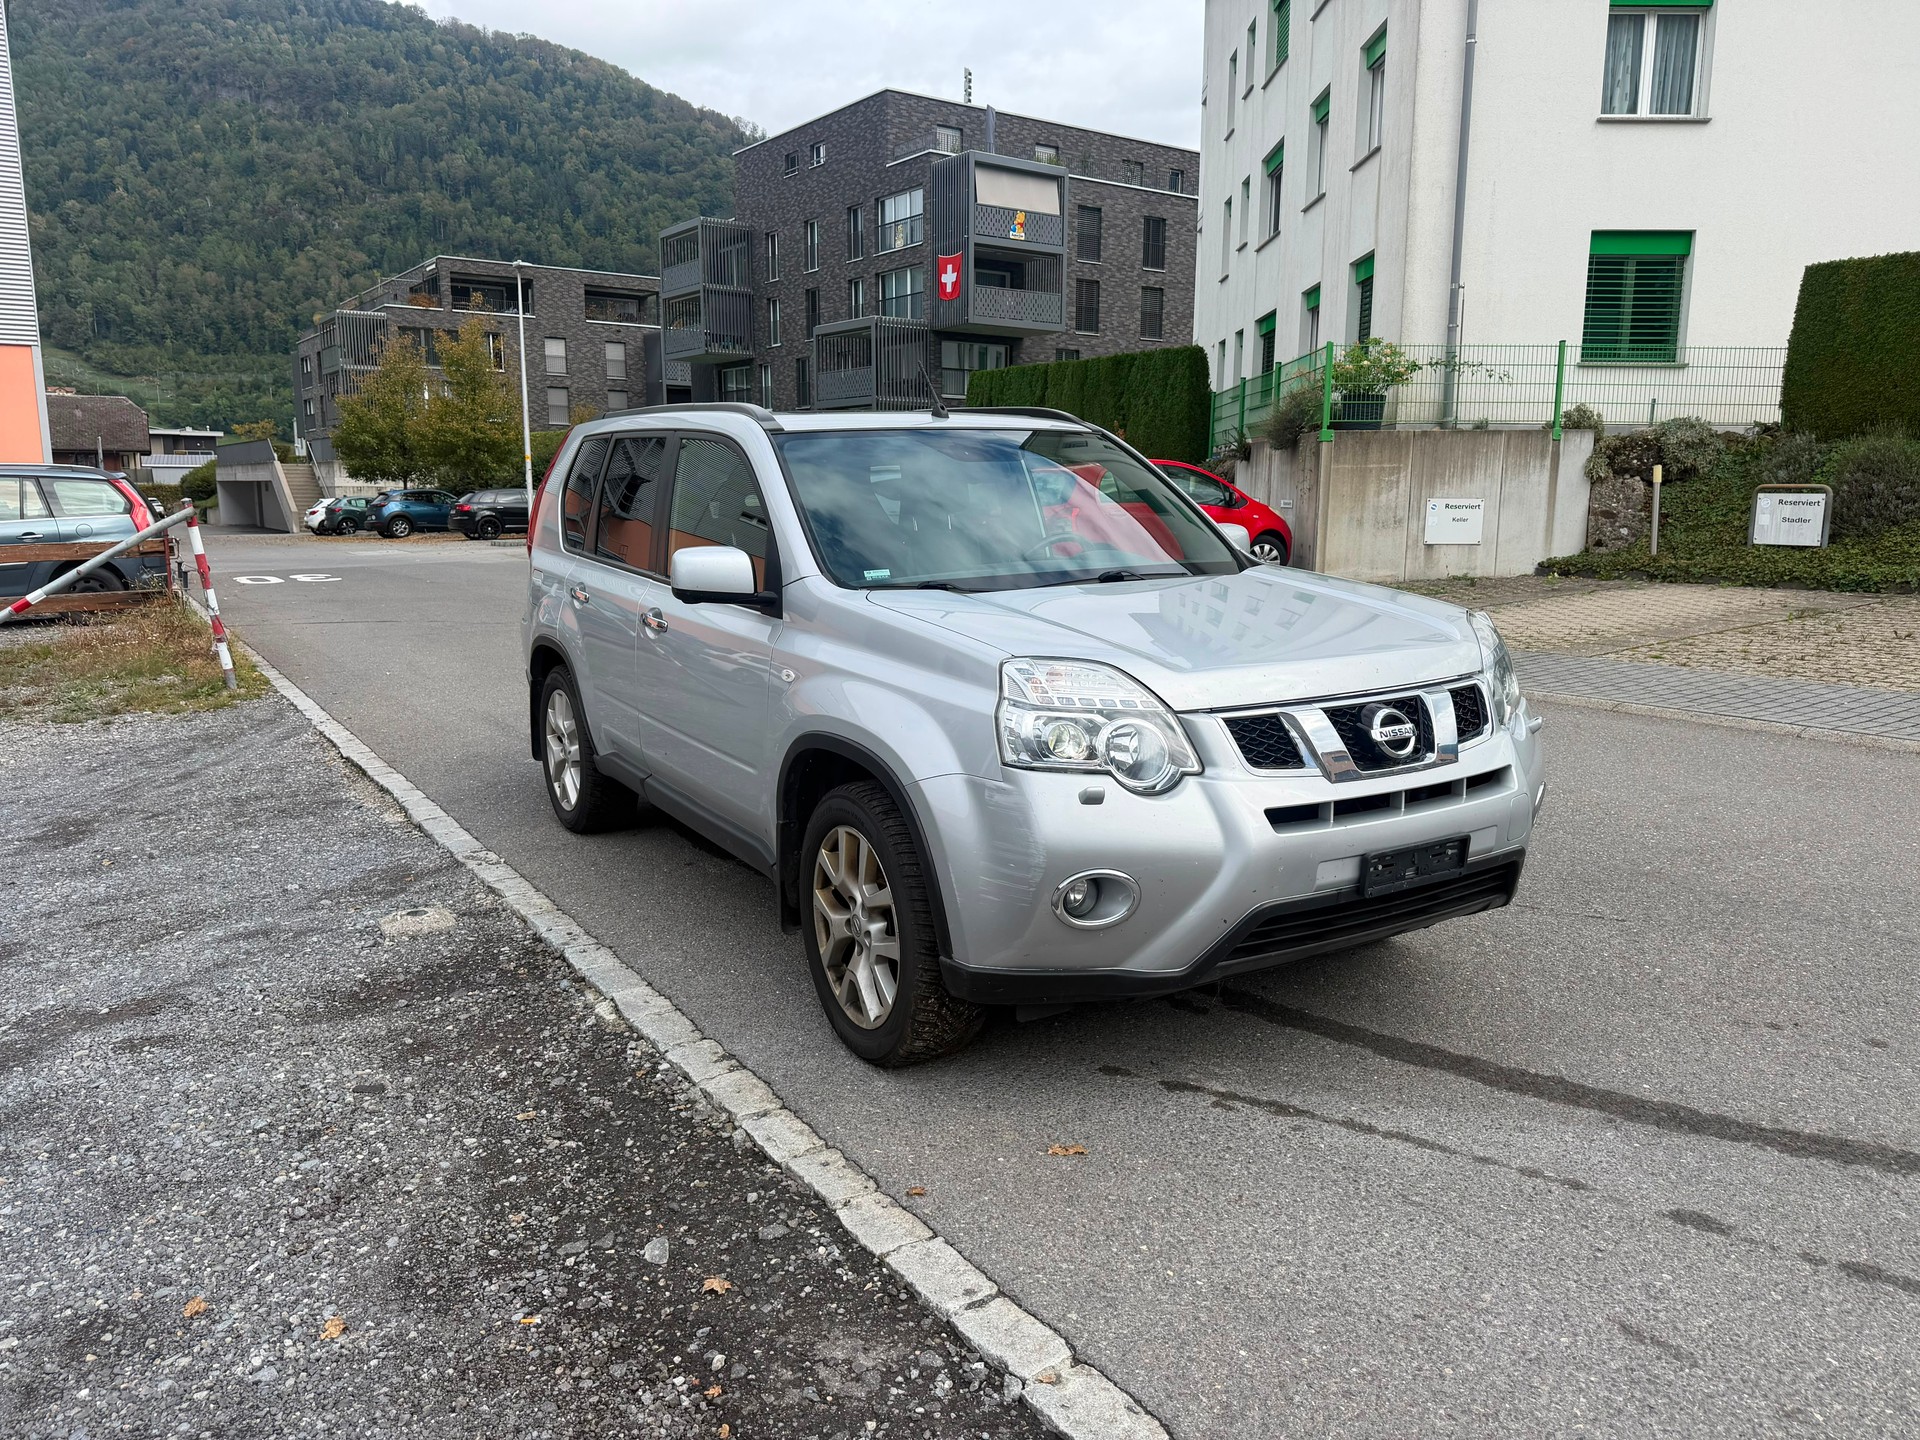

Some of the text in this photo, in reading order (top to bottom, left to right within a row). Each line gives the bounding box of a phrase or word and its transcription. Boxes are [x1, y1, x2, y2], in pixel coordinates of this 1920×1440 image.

[1778, 499, 1821, 507] Reserviert
[233, 574, 342, 584] 30
[1379, 726, 1416, 739] NISSAN
